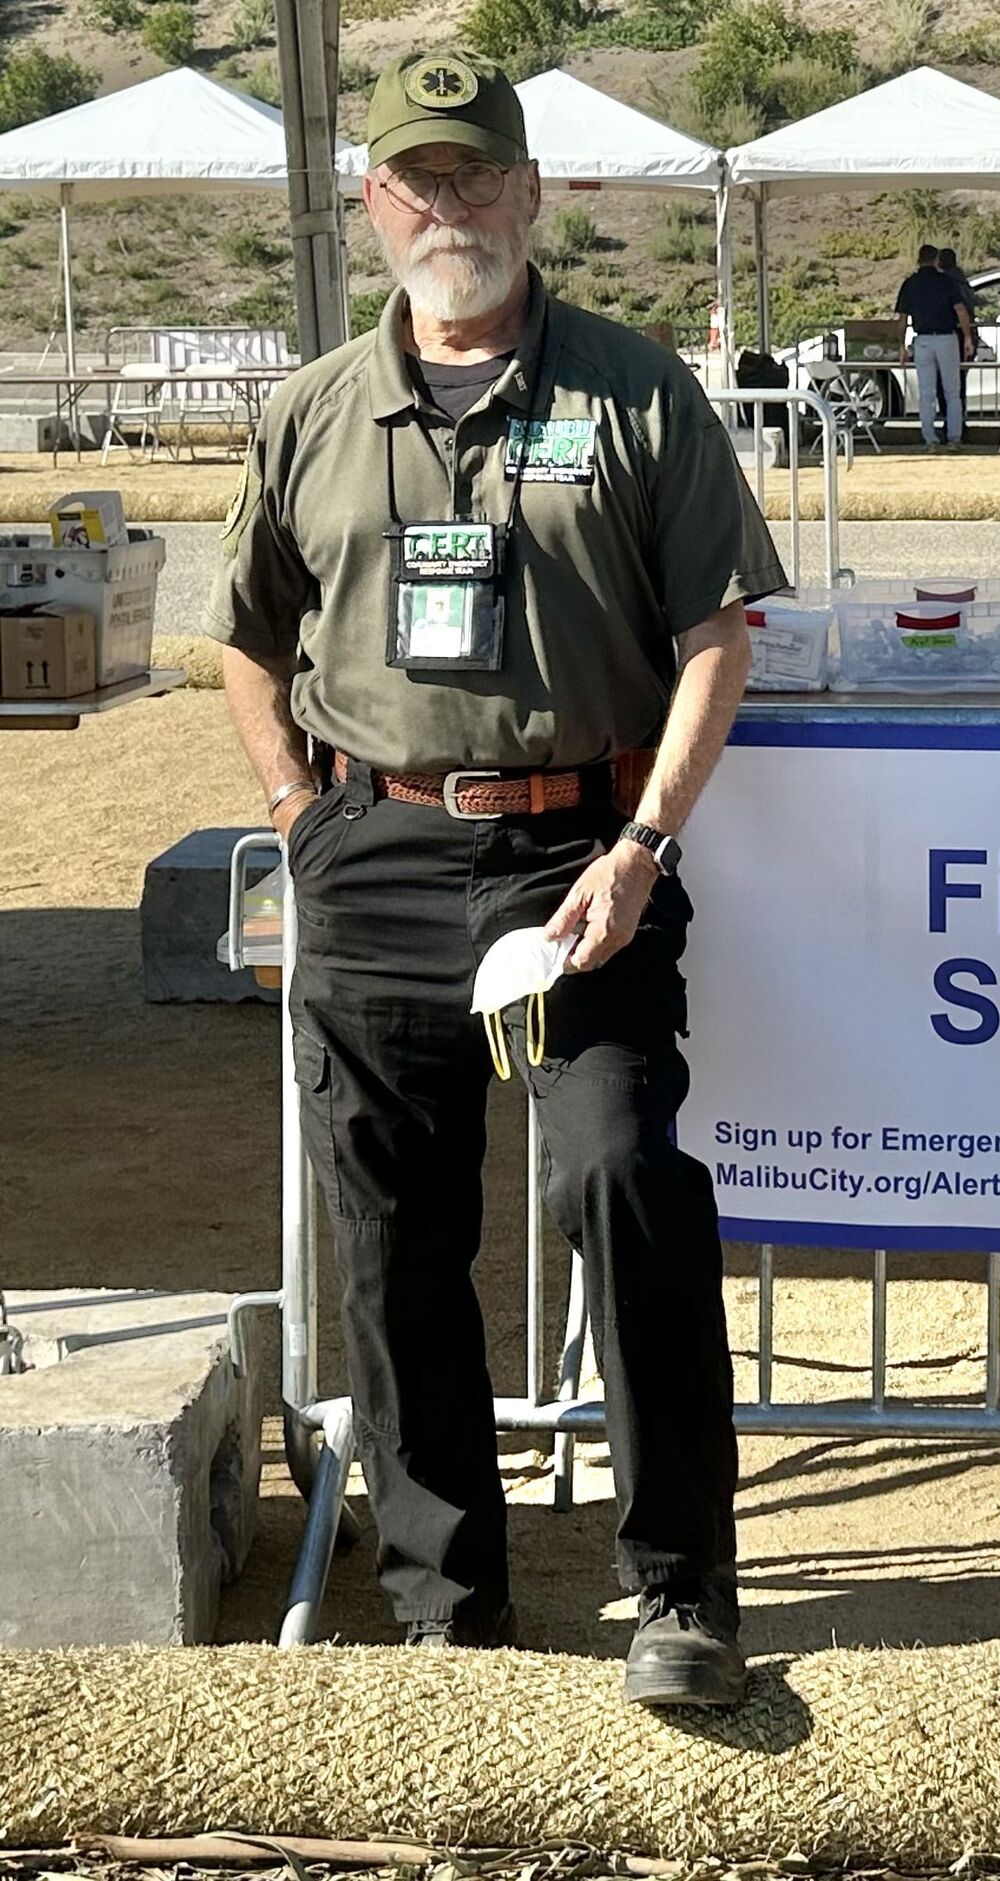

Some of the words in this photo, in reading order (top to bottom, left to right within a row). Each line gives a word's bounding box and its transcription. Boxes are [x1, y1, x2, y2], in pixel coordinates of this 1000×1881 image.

[508, 437, 592, 468] CERT
[408, 531, 488, 560] CERT
[715, 1120, 777, 1152] Sign
[787, 1129, 823, 1155] up
[830, 1125, 873, 1151] for
